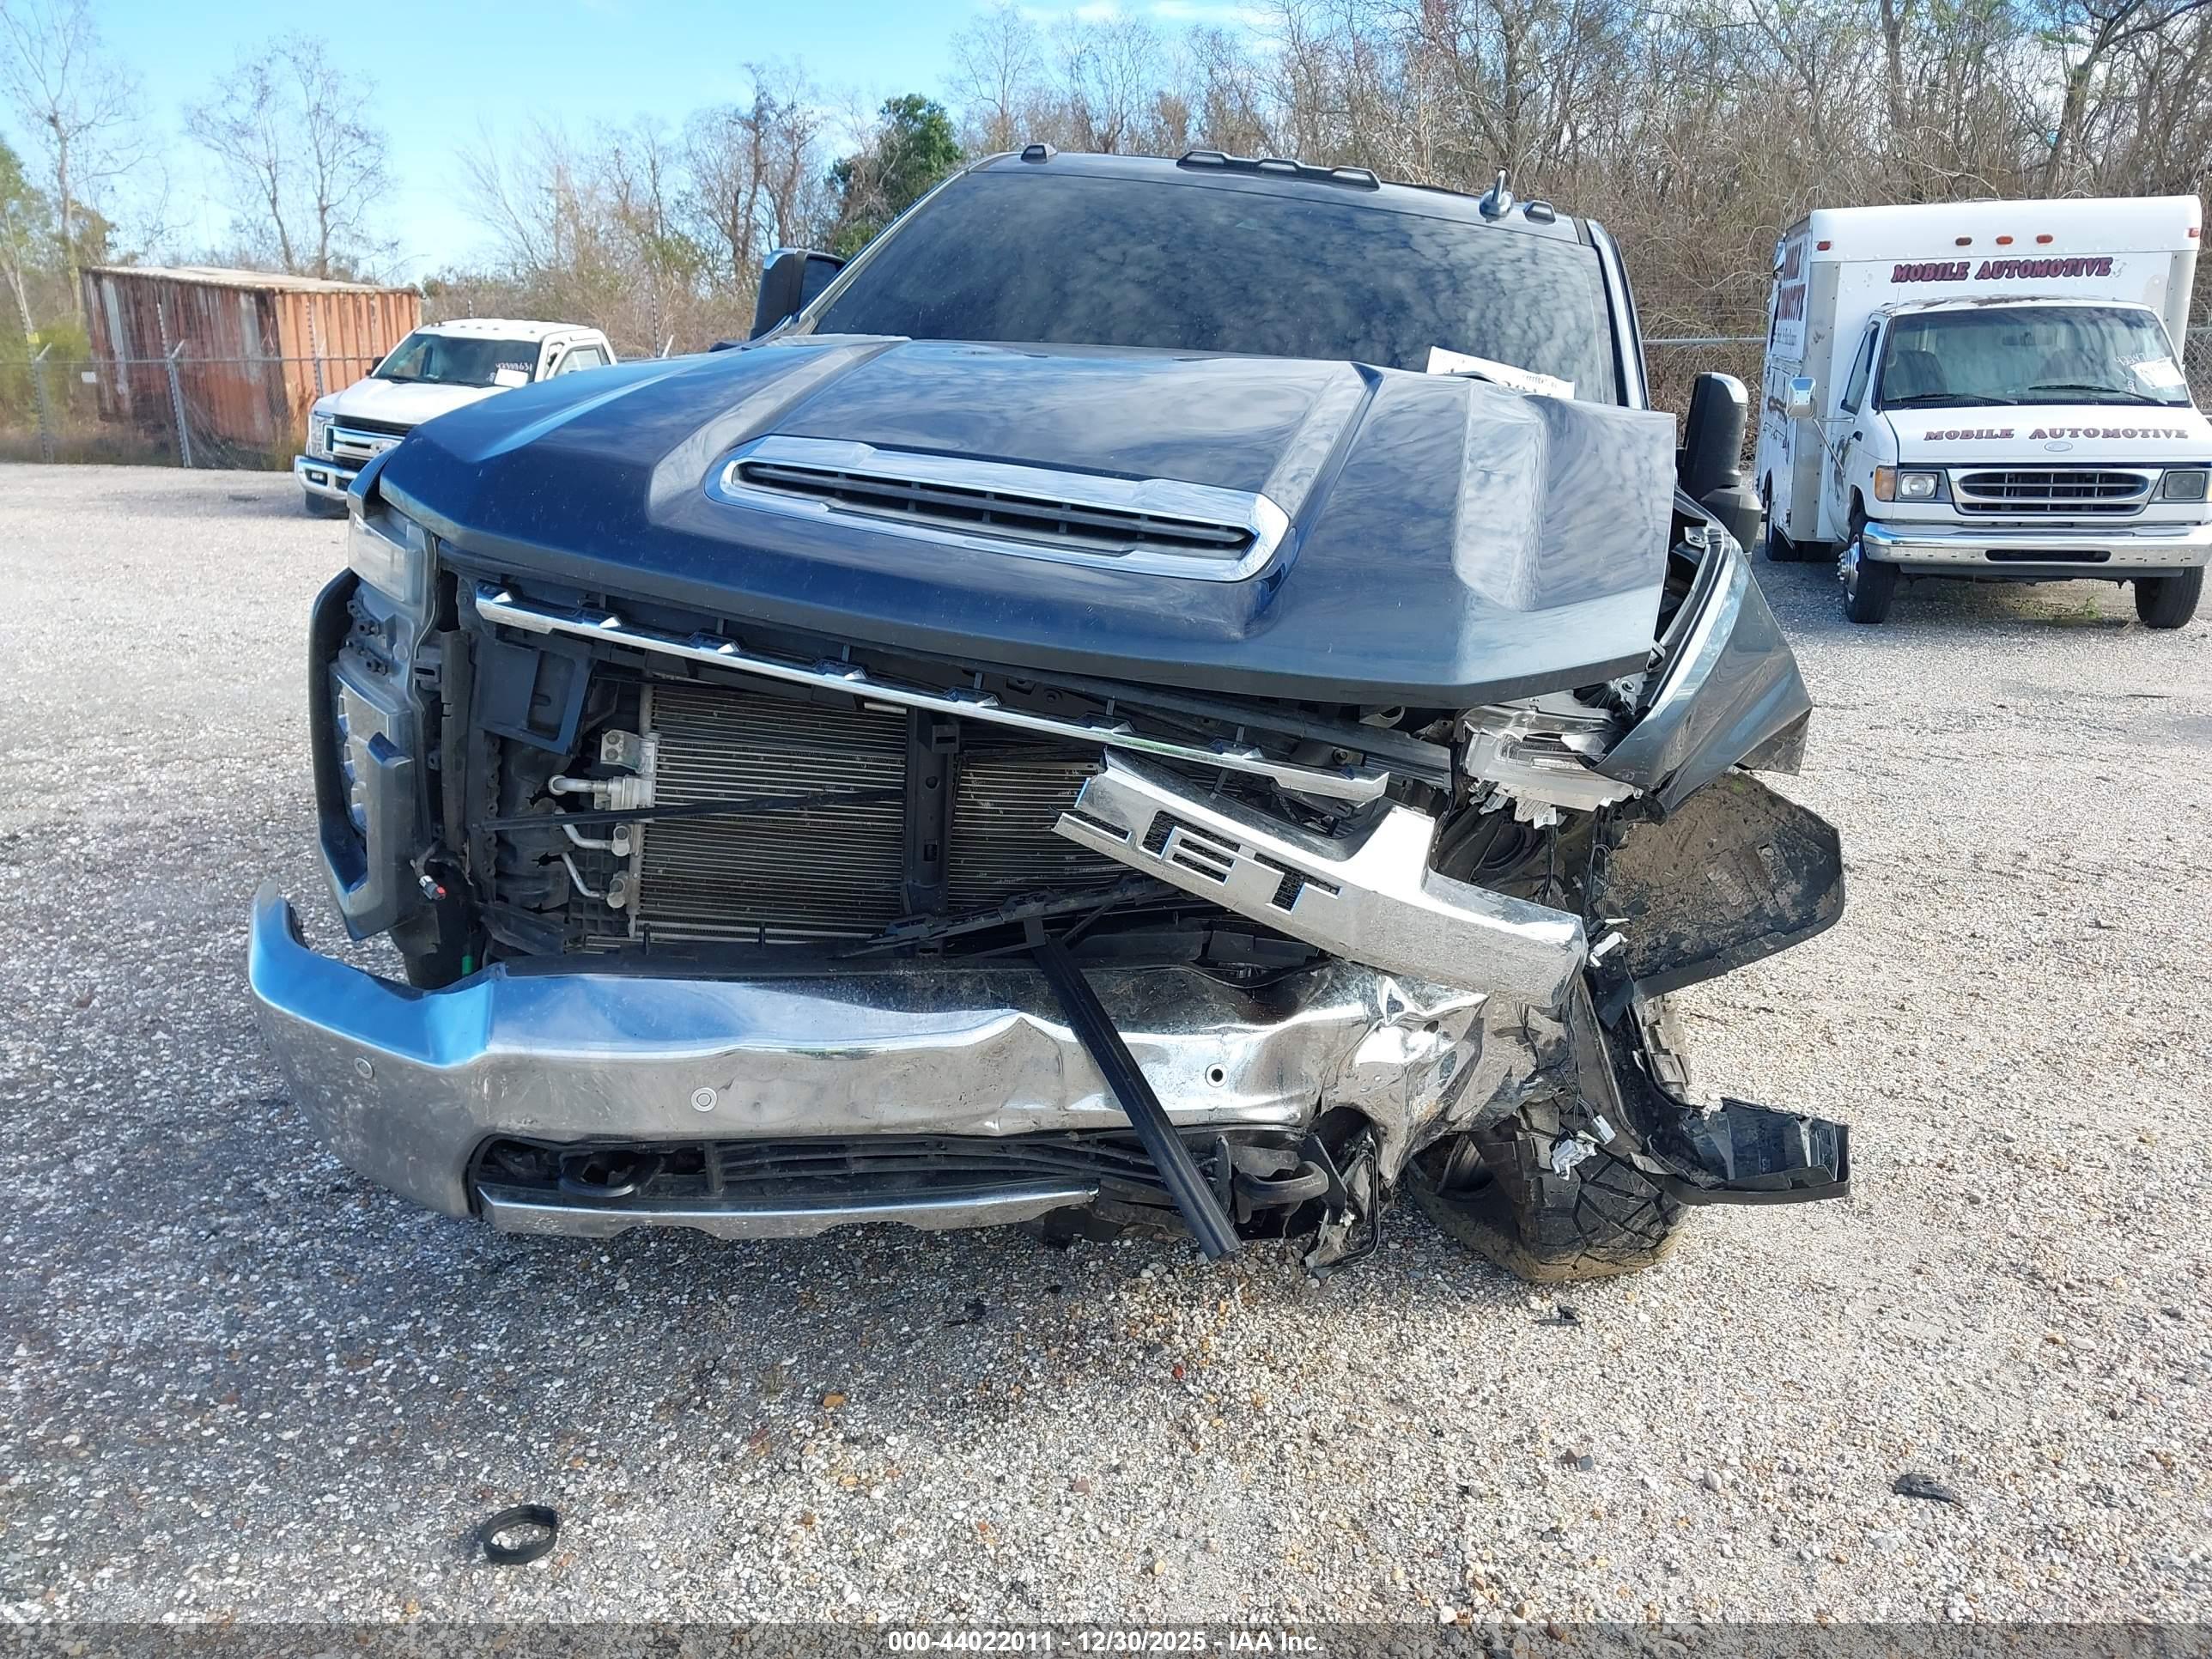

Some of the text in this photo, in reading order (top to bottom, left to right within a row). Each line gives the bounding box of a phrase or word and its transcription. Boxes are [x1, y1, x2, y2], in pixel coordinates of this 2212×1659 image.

[1891, 257, 2114, 283] MOBILE AUTOMOTIVE
[1923, 428, 2189, 441] MOBILE AUTOMOTIVE
